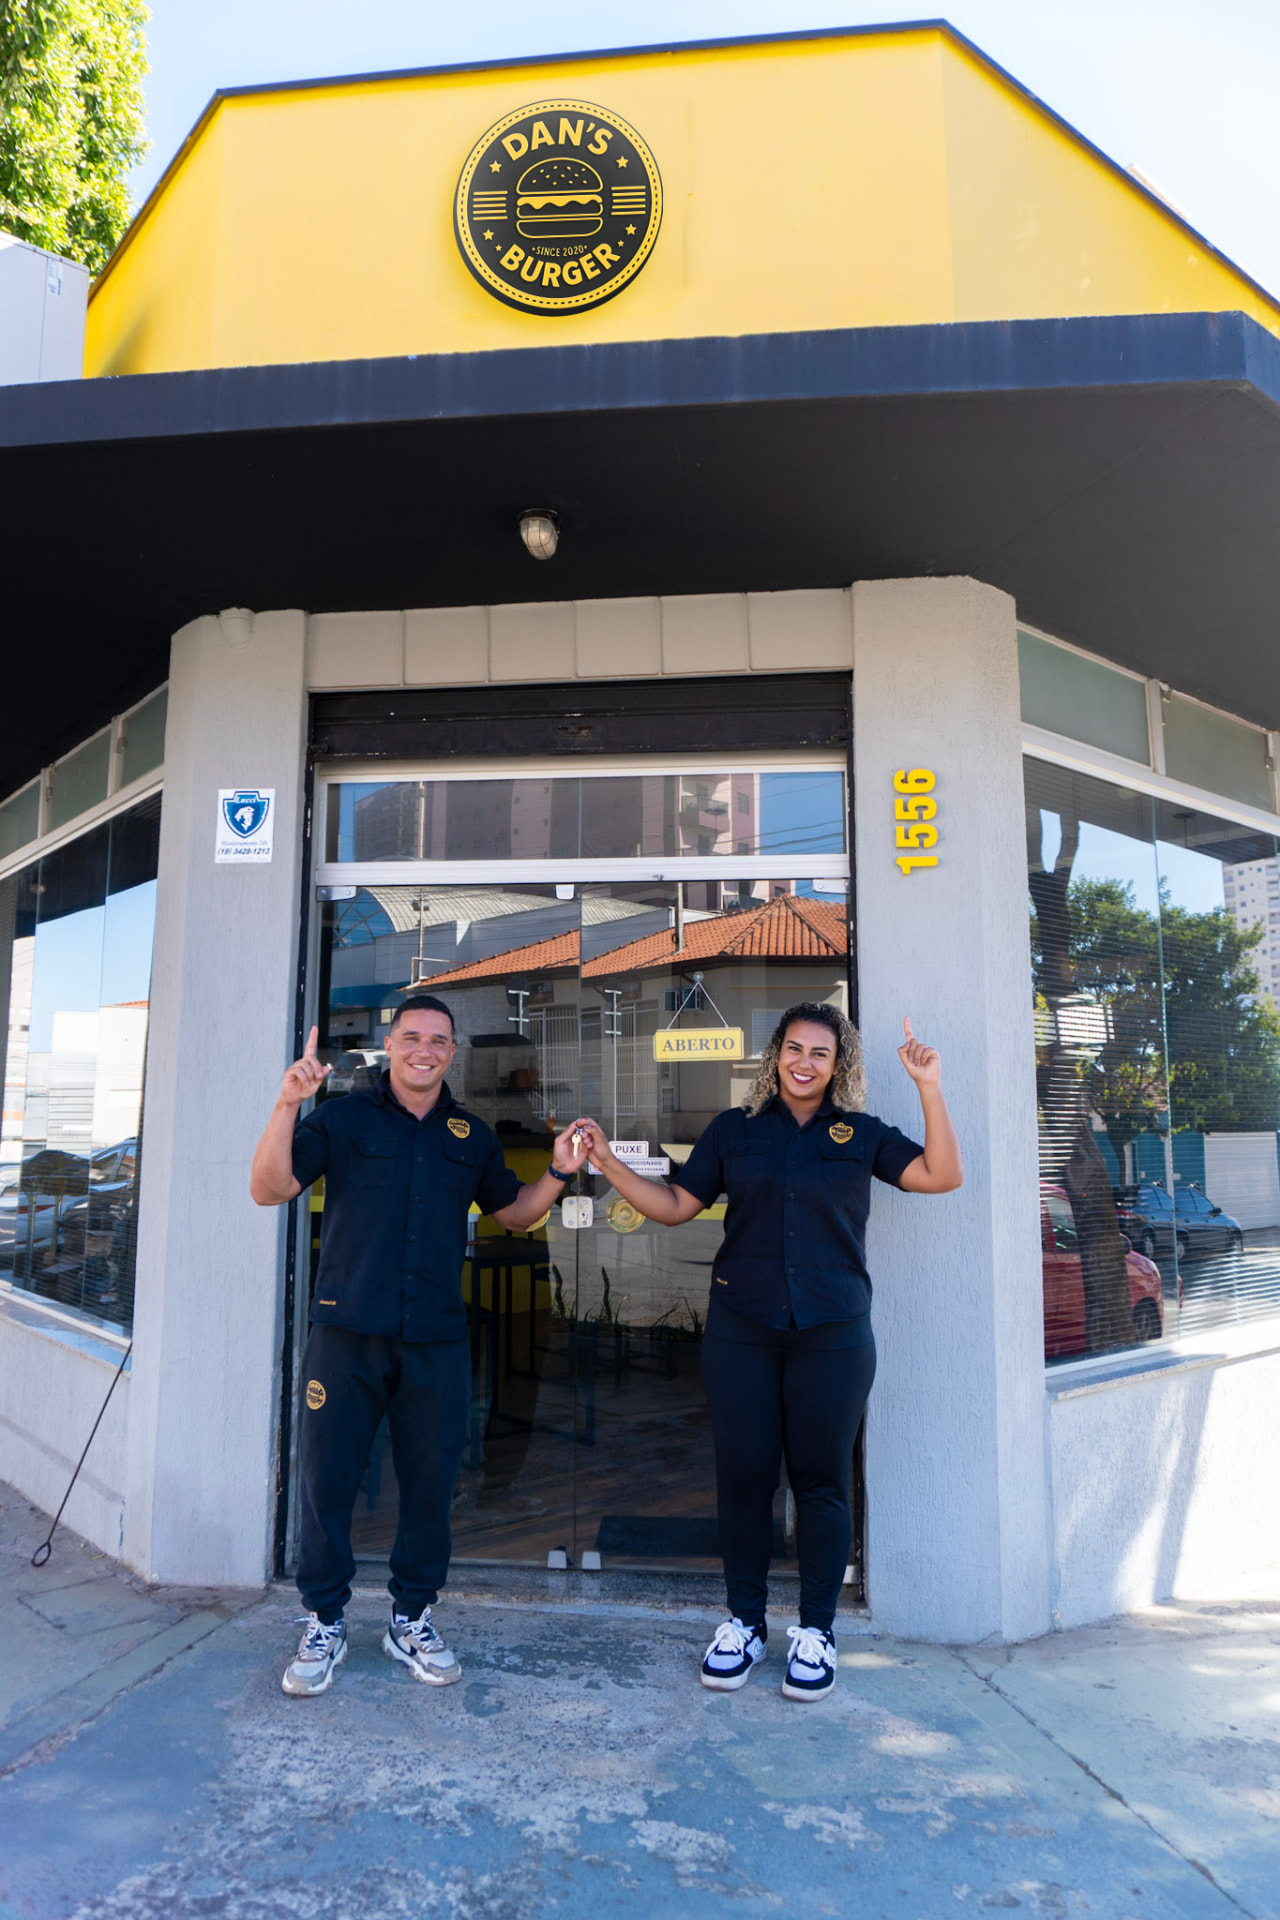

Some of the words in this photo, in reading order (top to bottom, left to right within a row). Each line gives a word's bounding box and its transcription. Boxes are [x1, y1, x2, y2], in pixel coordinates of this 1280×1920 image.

[501, 117, 613, 161] DAN'S
[535, 245, 560, 257] SINCE
[562, 244, 584, 257] 2020
[499, 243, 621, 288] BURGER
[893, 768, 938, 875] 1556
[217, 847, 232, 856] (19)
[662, 1037, 735, 1052] ABERTO
[615, 1145, 643, 1154] PUXE
